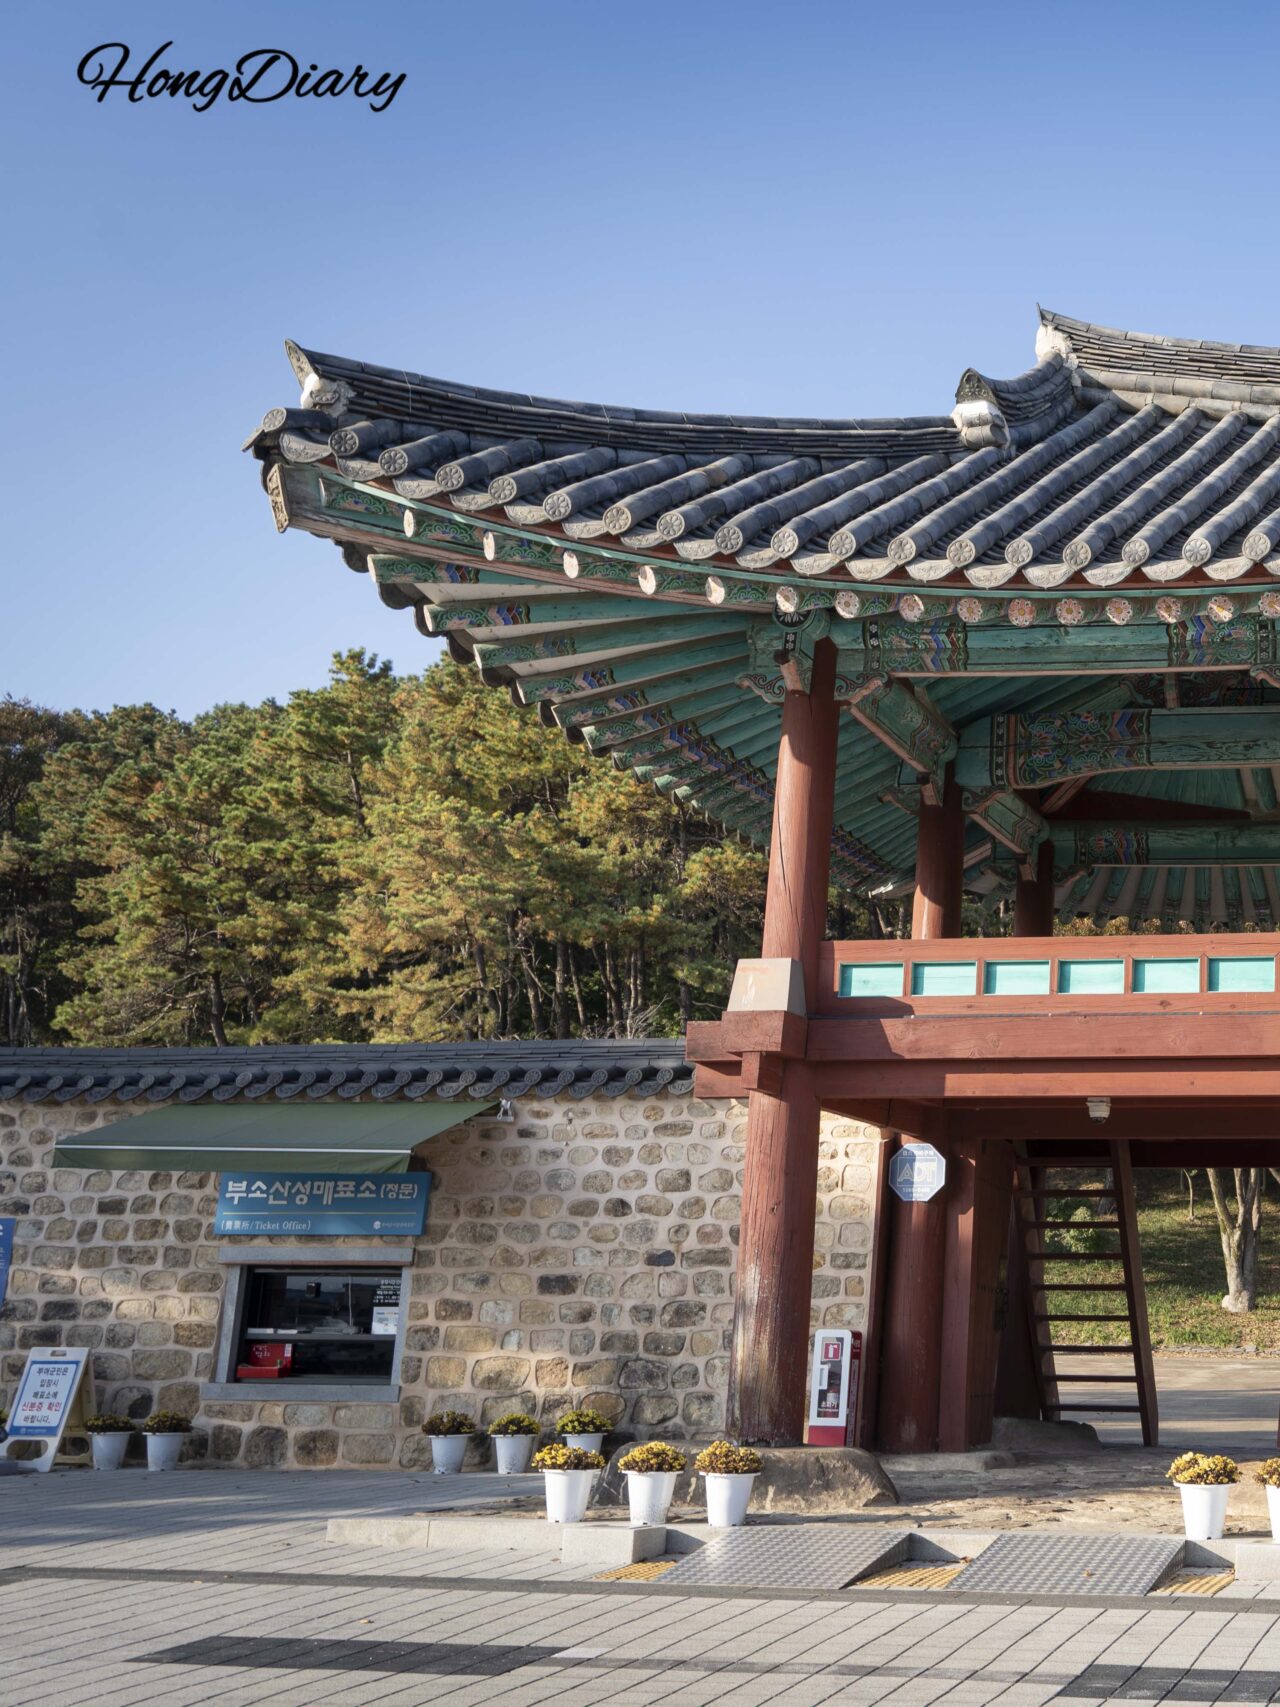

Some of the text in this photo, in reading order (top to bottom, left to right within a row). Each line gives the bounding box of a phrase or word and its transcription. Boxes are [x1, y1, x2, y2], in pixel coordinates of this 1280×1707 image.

[898, 1161, 936, 1182] ADT
[36, 1367, 69, 1376] 부여군민은
[40, 1378, 59, 1388] 입장시
[21, 1402, 62, 1412] 신분증 확인
